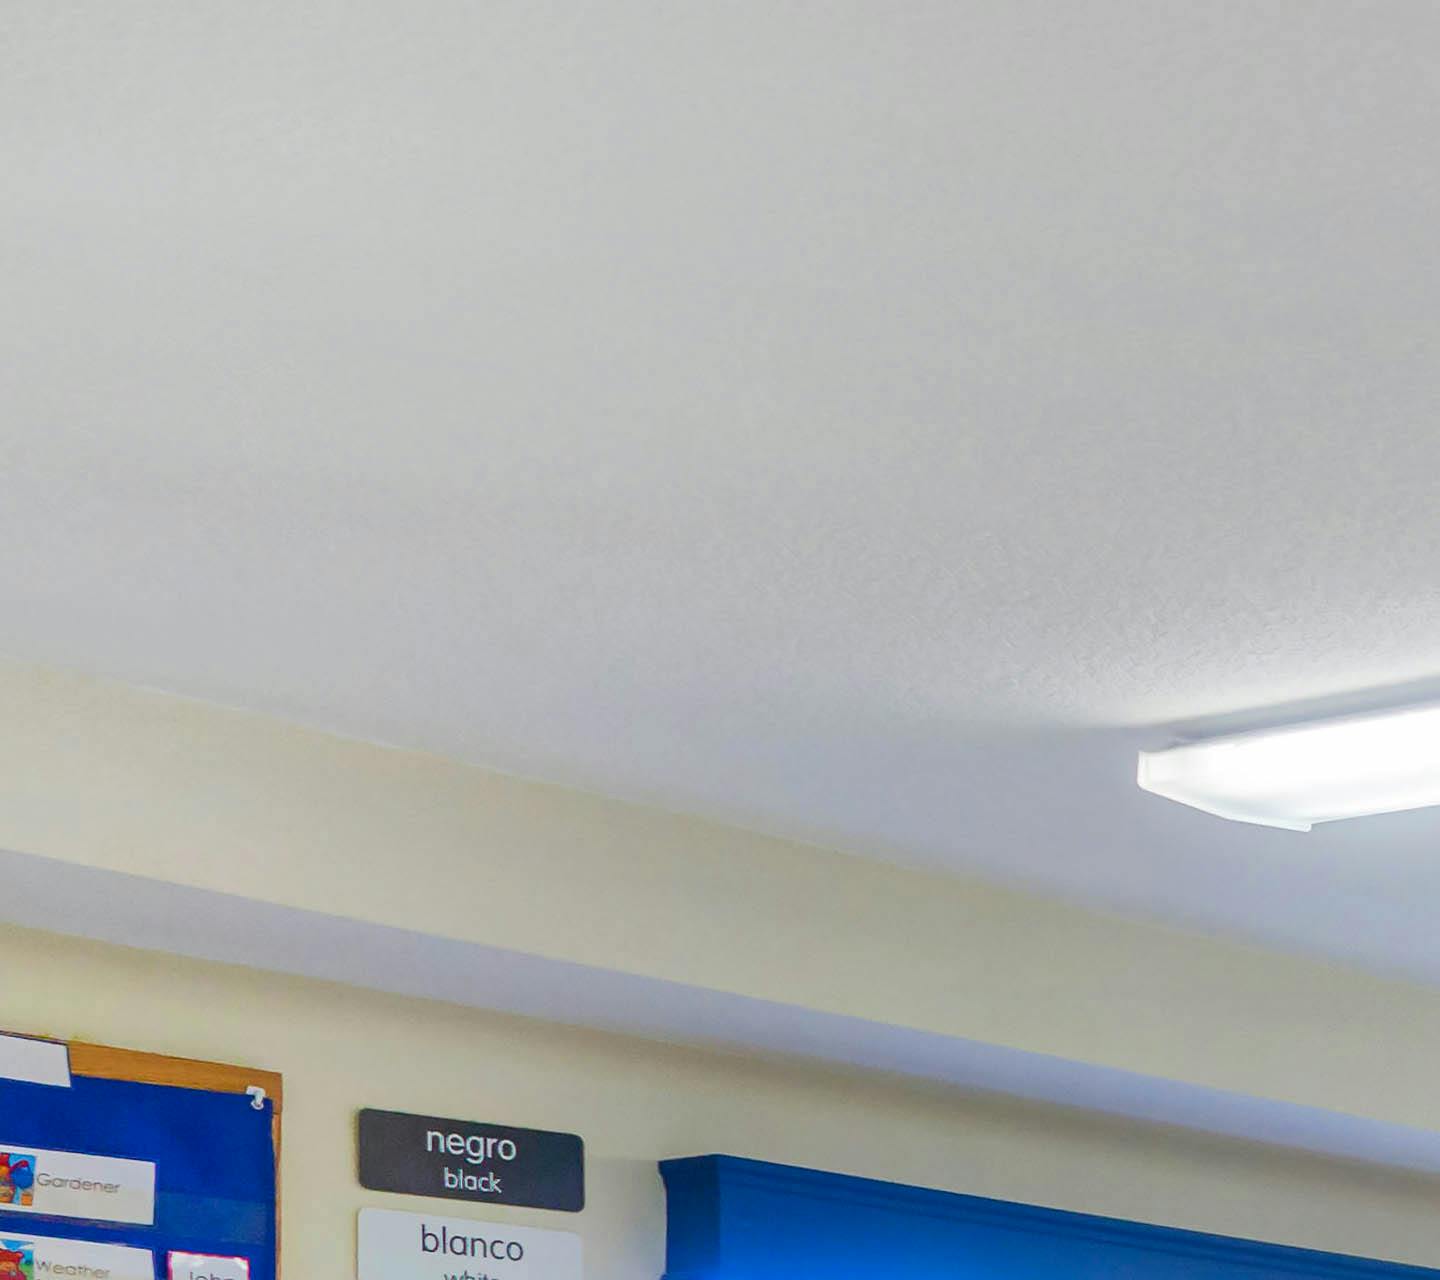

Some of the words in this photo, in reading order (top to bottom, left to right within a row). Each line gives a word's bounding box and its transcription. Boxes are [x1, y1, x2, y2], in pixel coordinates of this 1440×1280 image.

[426, 1130, 517, 1164] negro
[36, 1173, 121, 1194] Gardener
[444, 1167, 502, 1193] black
[421, 1224, 524, 1262] blanco
[36, 1260, 110, 1279] Weather
